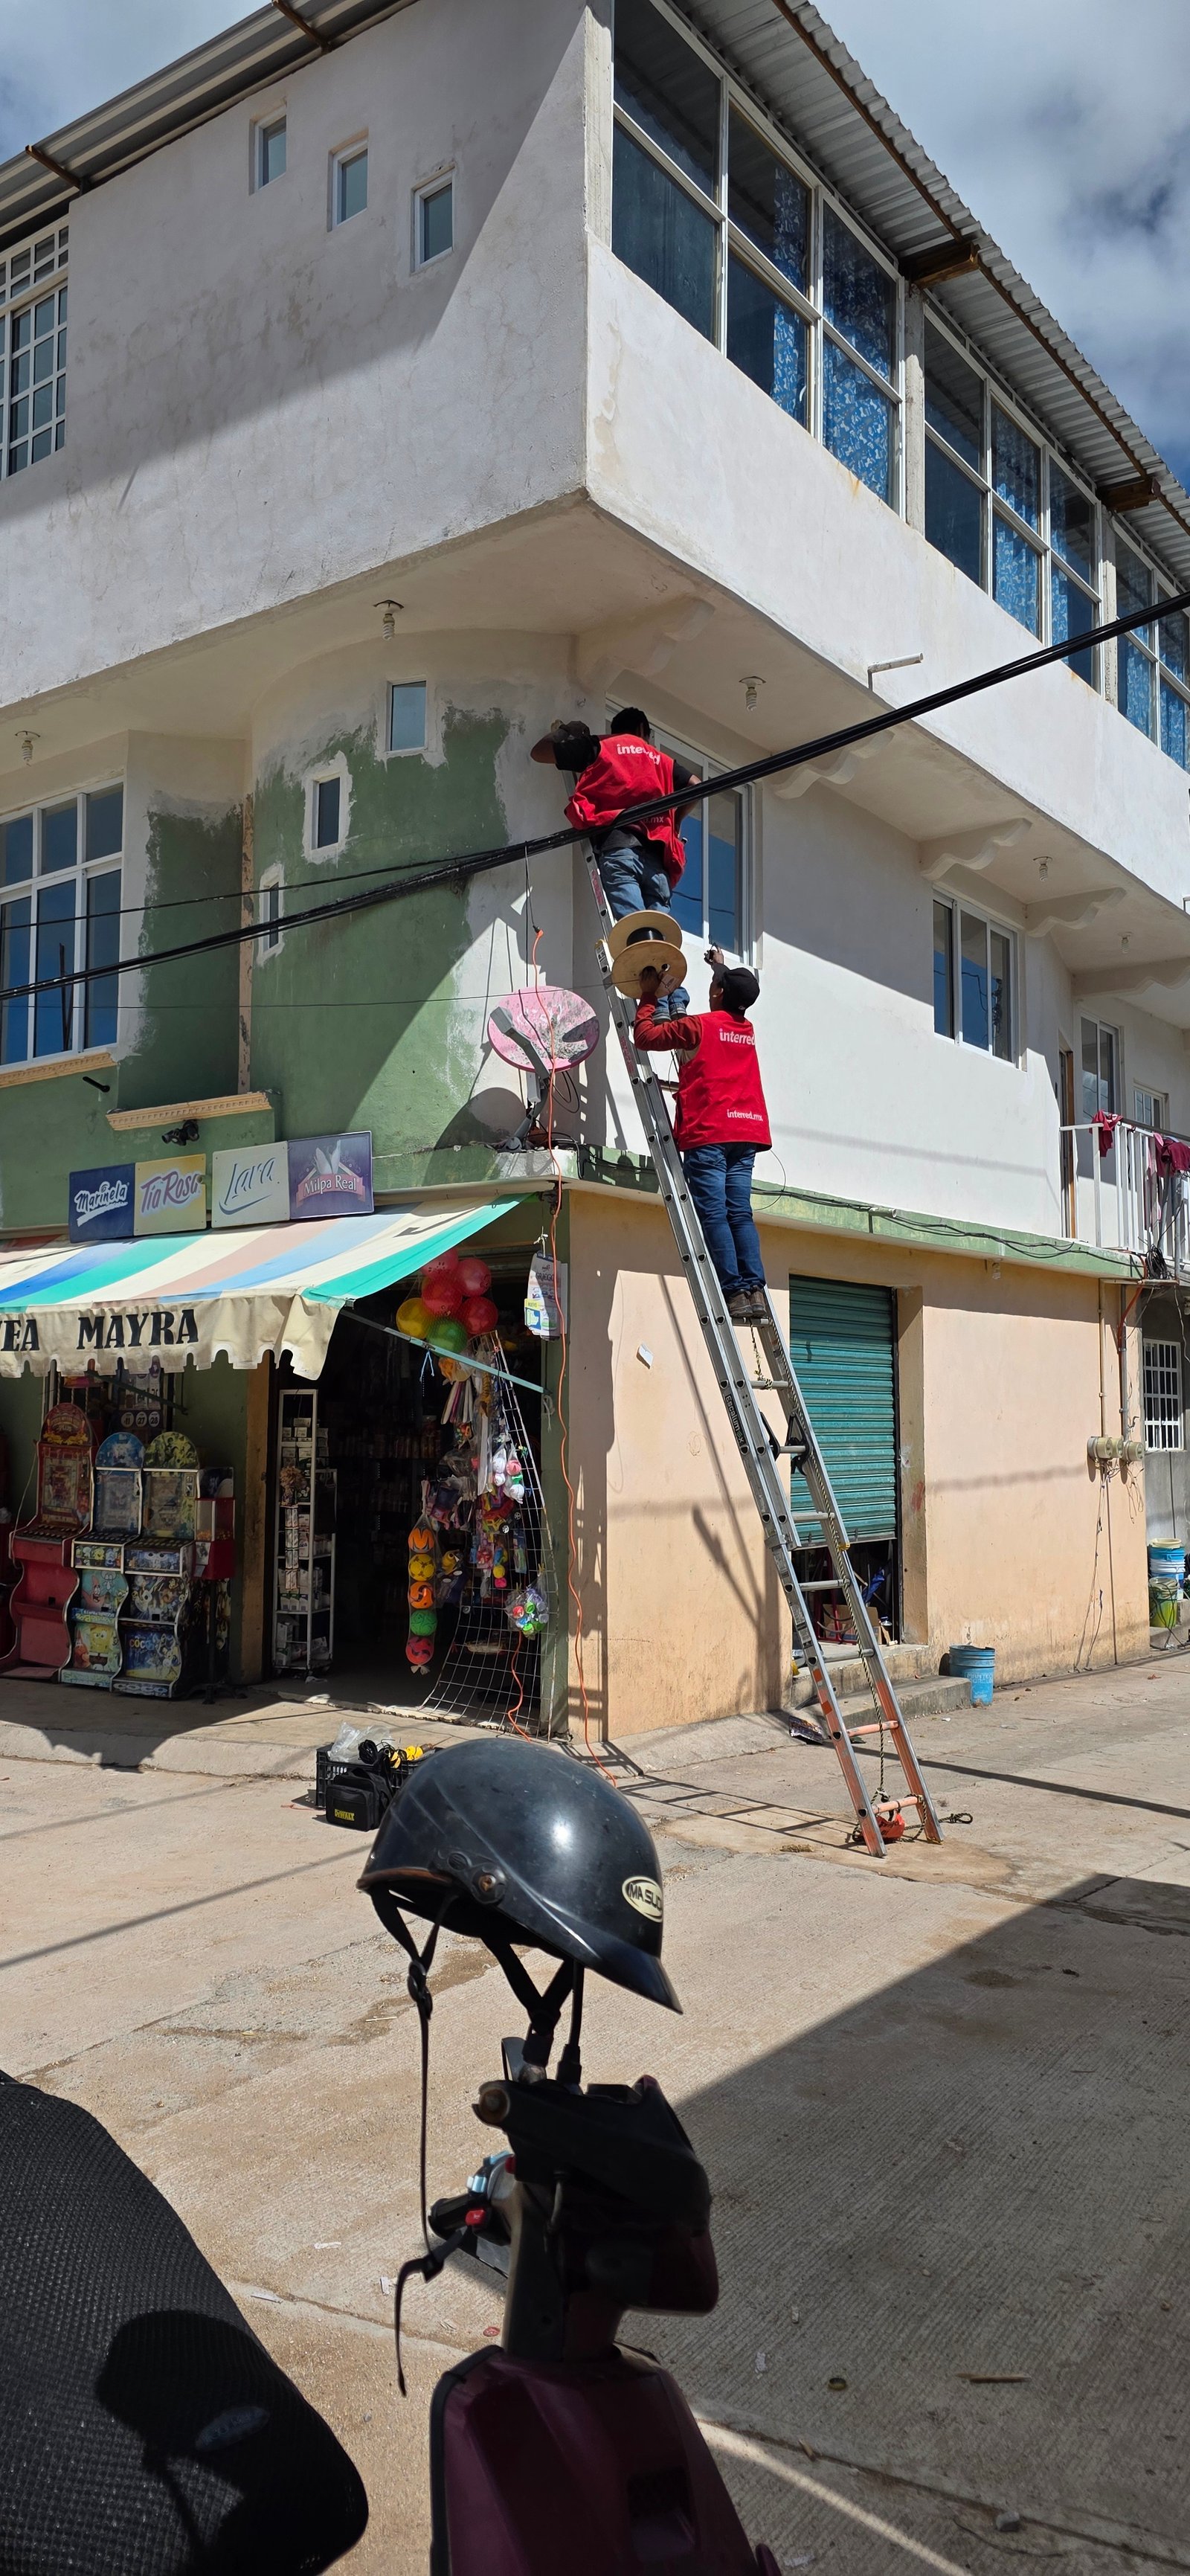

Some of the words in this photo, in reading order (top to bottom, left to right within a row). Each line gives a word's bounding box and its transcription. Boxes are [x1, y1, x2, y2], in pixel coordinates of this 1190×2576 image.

[727, 1109, 764, 1122] interred.mx
[74, 1181, 128, 1213] Marinela
[161, 1171, 199, 1204] Rosa
[223, 1157, 276, 1206] Lara
[303, 1178, 332, 1197] Milpa
[335, 1175, 357, 1192] Real
[0, 1319, 40, 1352] EA
[77, 1309, 199, 1350] MAYRA
